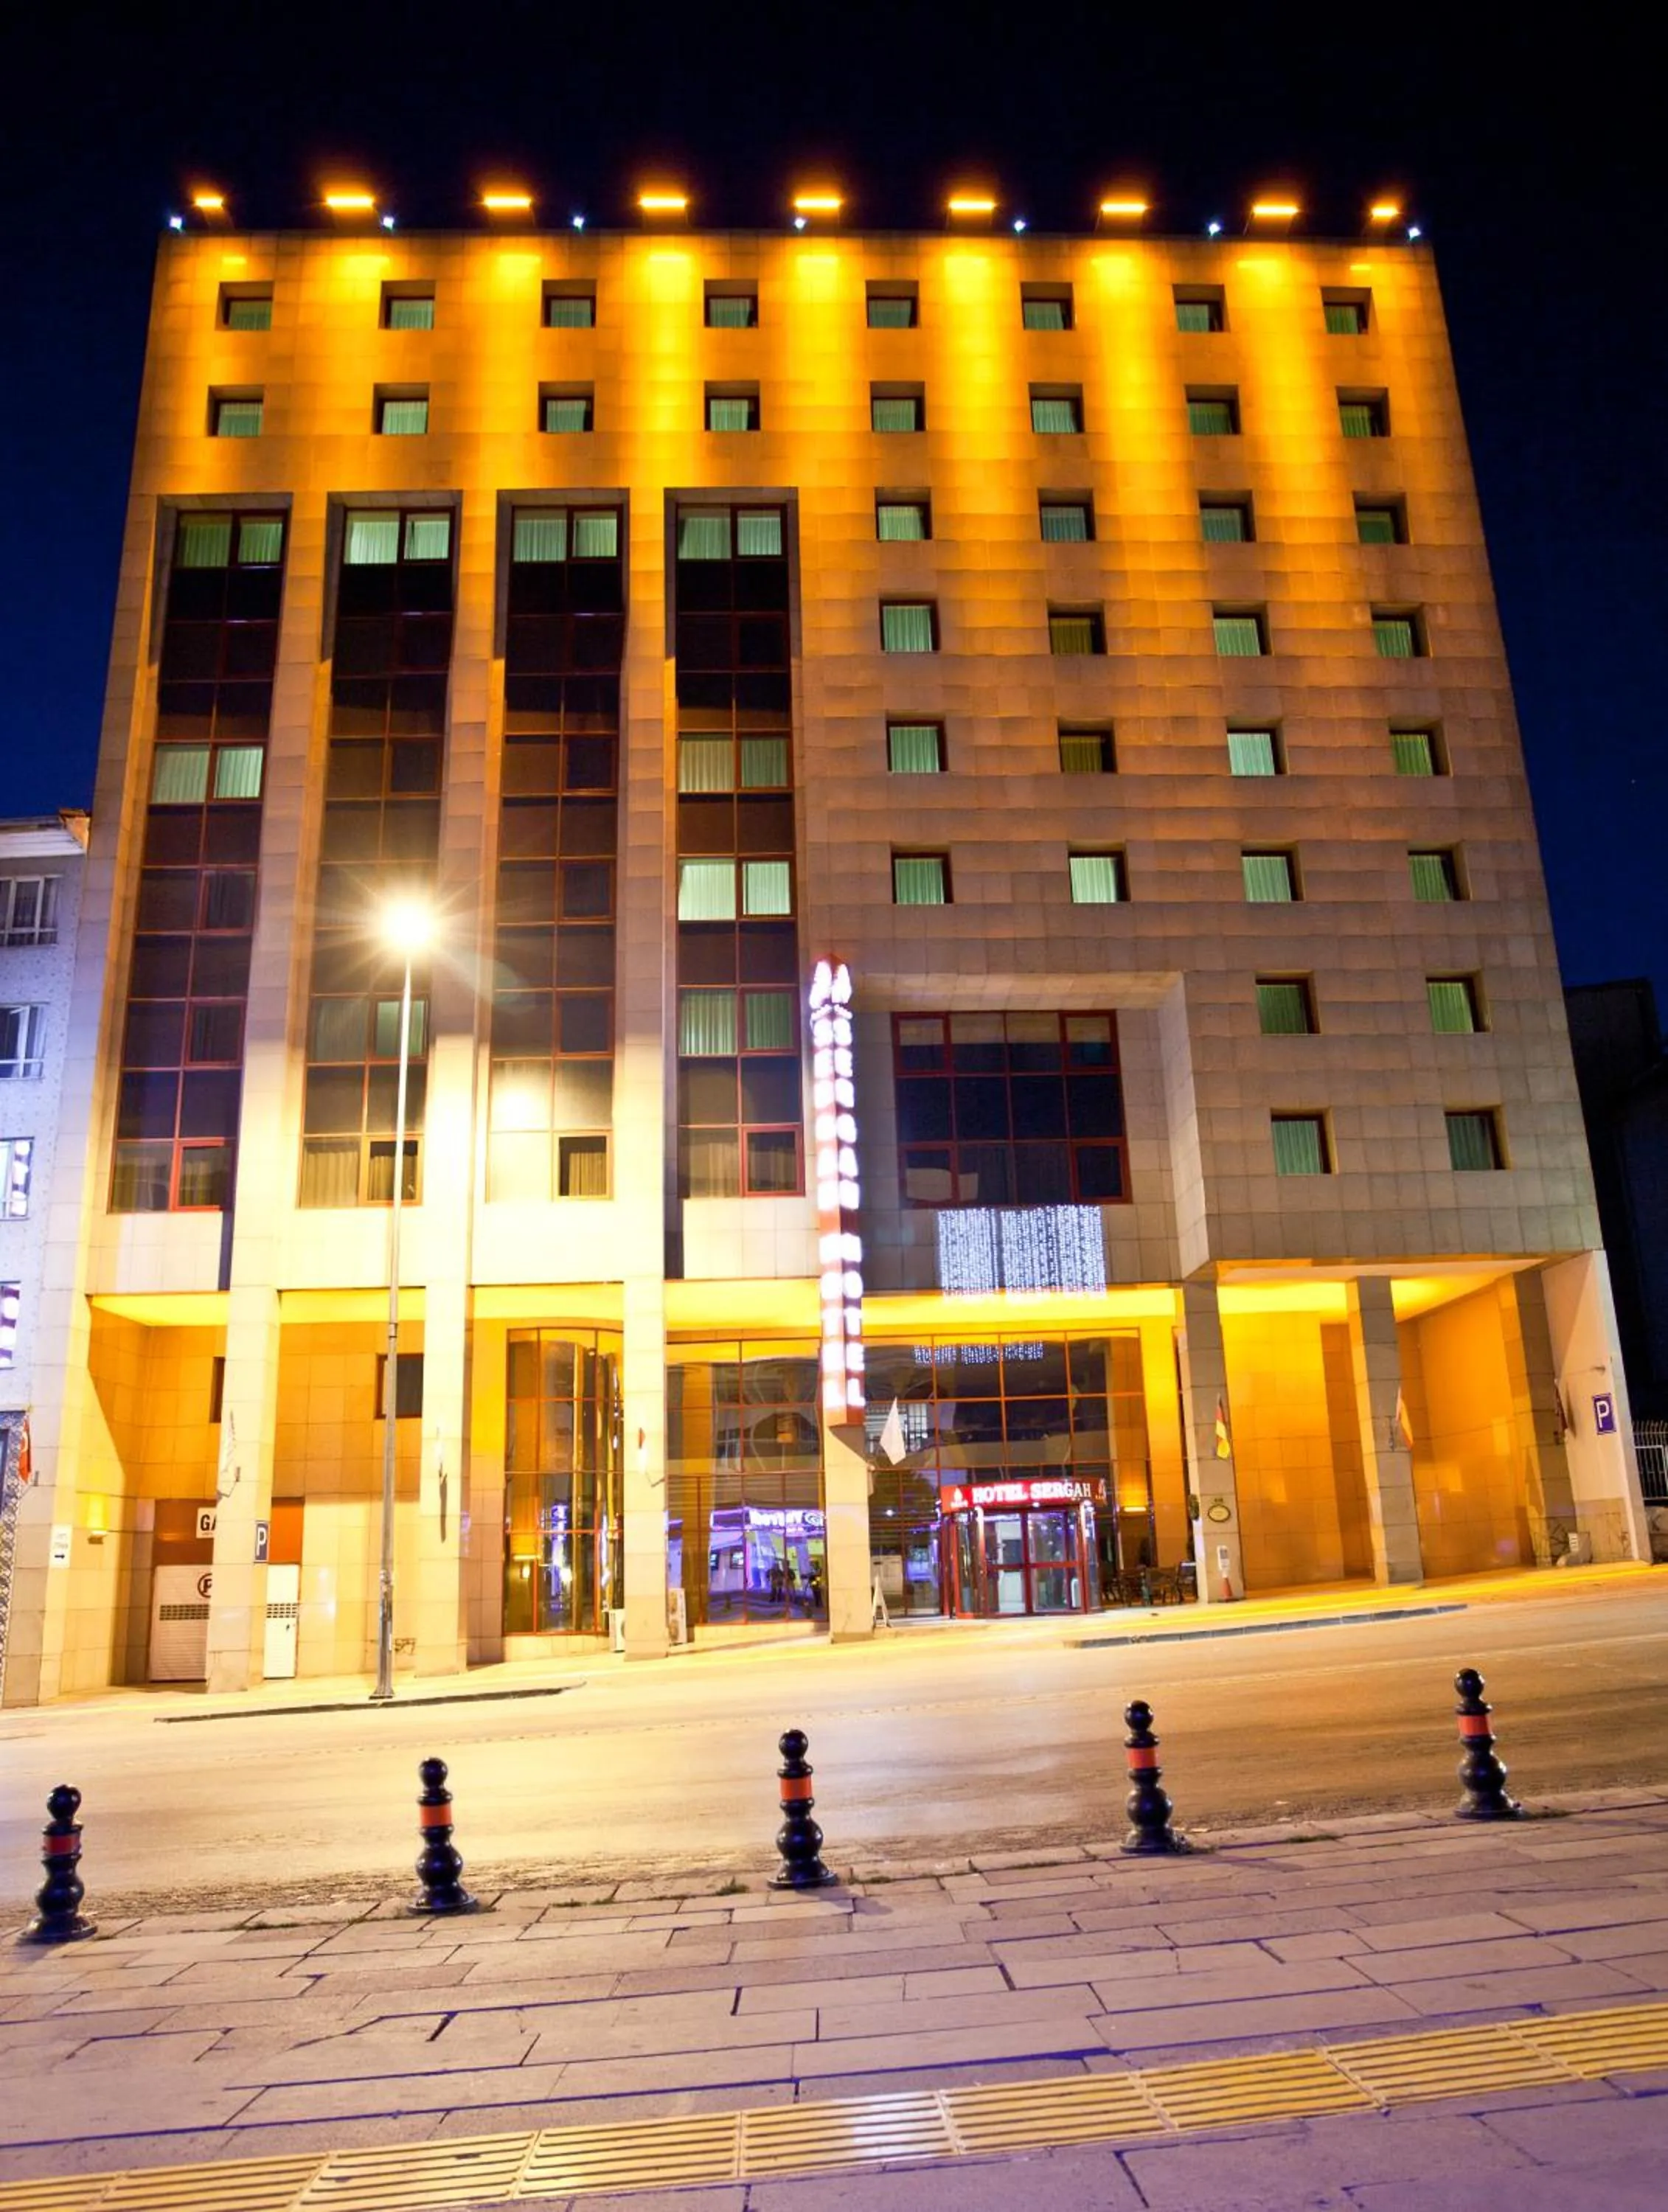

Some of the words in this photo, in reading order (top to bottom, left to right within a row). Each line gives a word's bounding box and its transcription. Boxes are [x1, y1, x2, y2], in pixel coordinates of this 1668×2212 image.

[841, 1233, 866, 1407] HOTEL
[1596, 1401, 1609, 1428] P
[972, 1484, 1028, 1503] HOTEL
[1030, 1482, 1091, 1500] SERGAH
[257, 1527, 266, 1556] P
